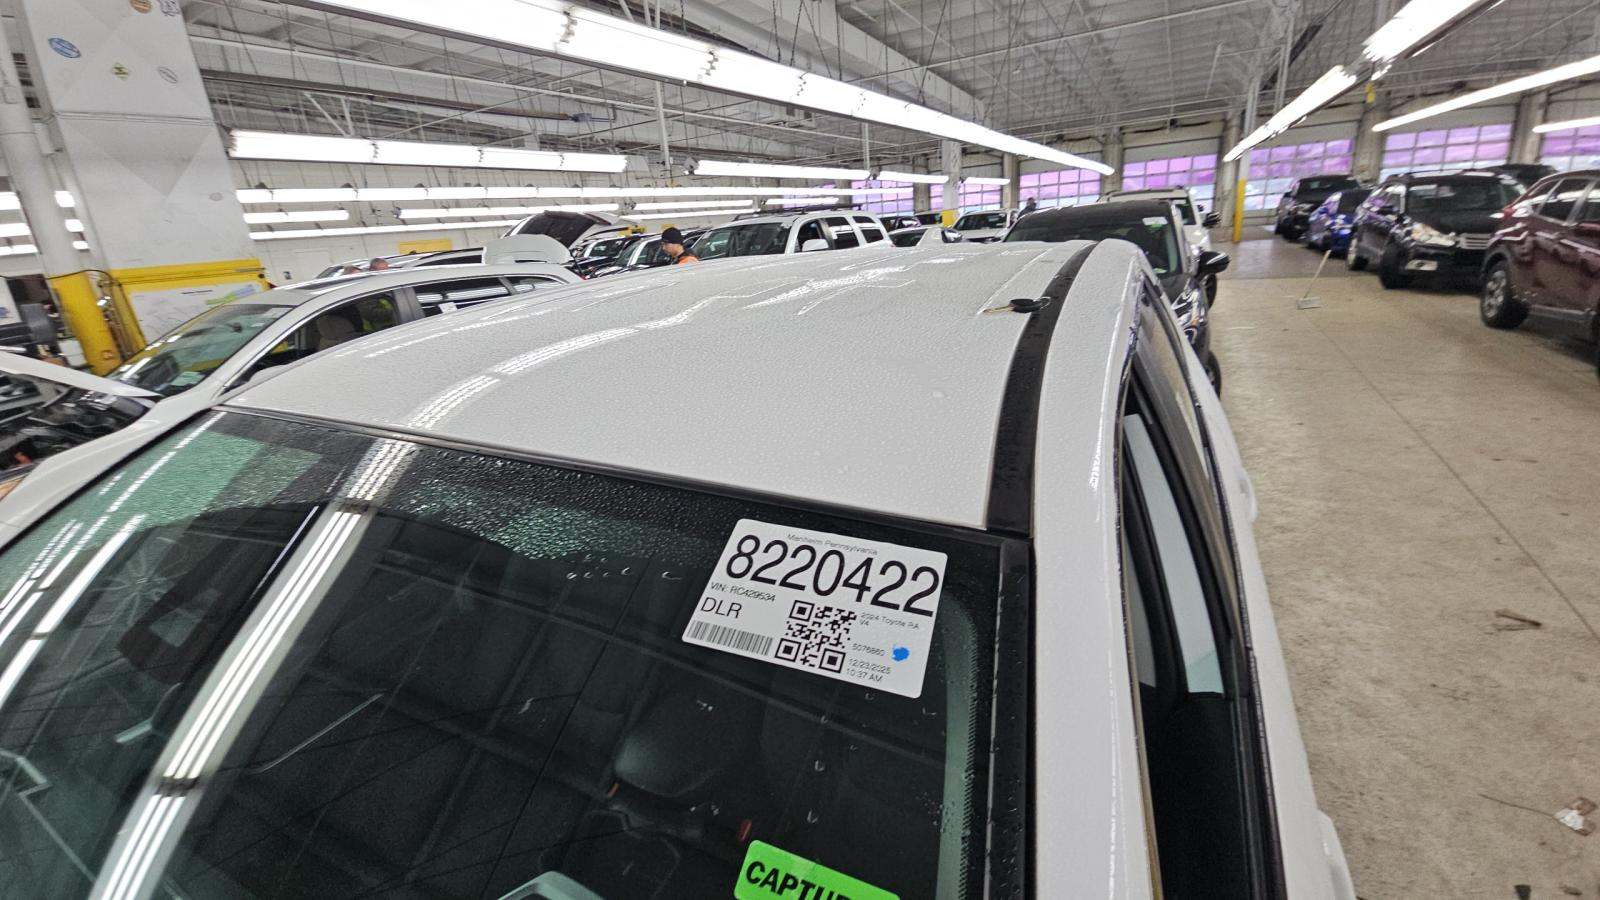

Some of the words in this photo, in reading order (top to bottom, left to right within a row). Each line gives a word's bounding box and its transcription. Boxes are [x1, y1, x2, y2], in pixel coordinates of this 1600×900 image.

[824, 539, 878, 556] Pennsylvania
[727, 534, 940, 617] 8220422
[711, 582, 727, 593] VIN:
[701, 596, 742, 618] DLR
[881, 615, 905, 627] Toyota
[869, 674, 883, 682] AM
